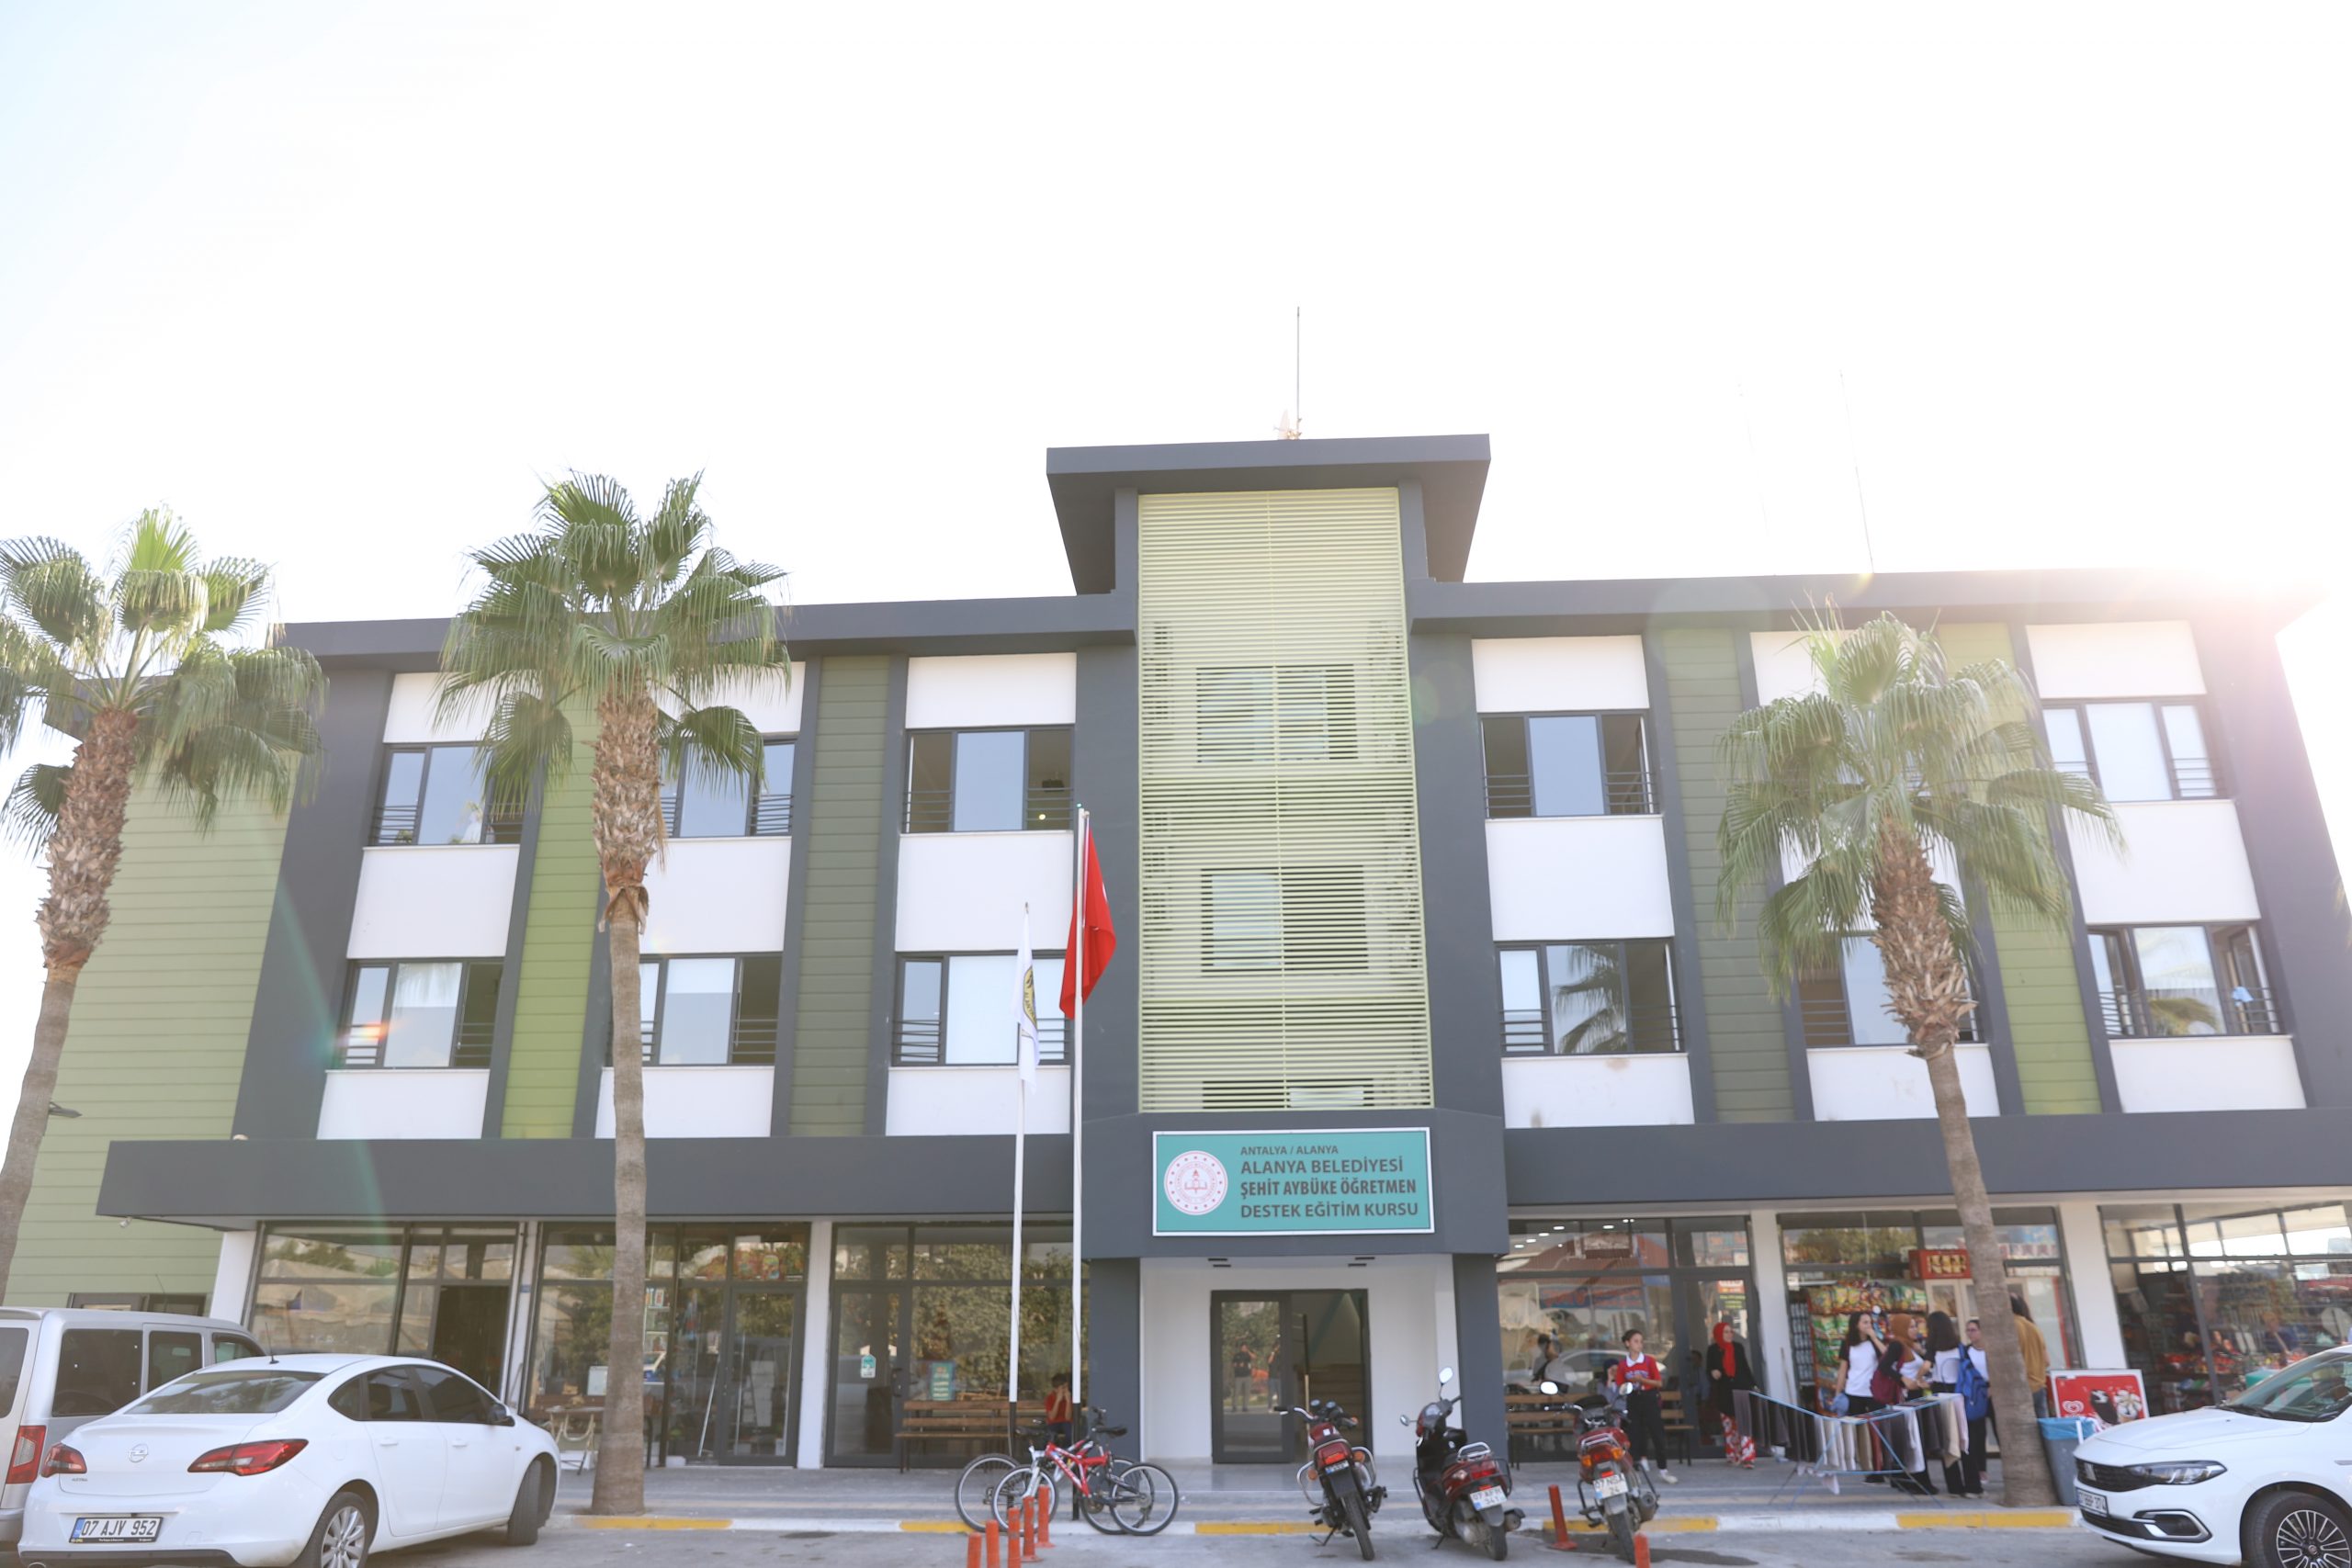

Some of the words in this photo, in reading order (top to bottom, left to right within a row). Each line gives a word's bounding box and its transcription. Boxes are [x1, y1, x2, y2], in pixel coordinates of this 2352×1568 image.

[1240, 1146, 1287, 1156] ANTALYA
[1290, 1146, 1294, 1155] /
[1296, 1145, 1339, 1155] ALANYA
[1241, 1160, 1307, 1174] ALANYA
[1311, 1156, 1403, 1173] BELEDİYESİ
[1240, 1178, 1280, 1200] ŞEHİT
[1283, 1177, 1337, 1195] AYBÜKE
[1340, 1177, 1417, 1194] ÖĞRETMEN
[1241, 1204, 1301, 1218] DESTEK
[1305, 1201, 1360, 1217] EĞİTİM
[1364, 1202, 1419, 1216] KURSU
[81, 1520, 99, 1536] 07
[100, 1520, 127, 1536] AJV
[130, 1520, 157, 1536] 952
